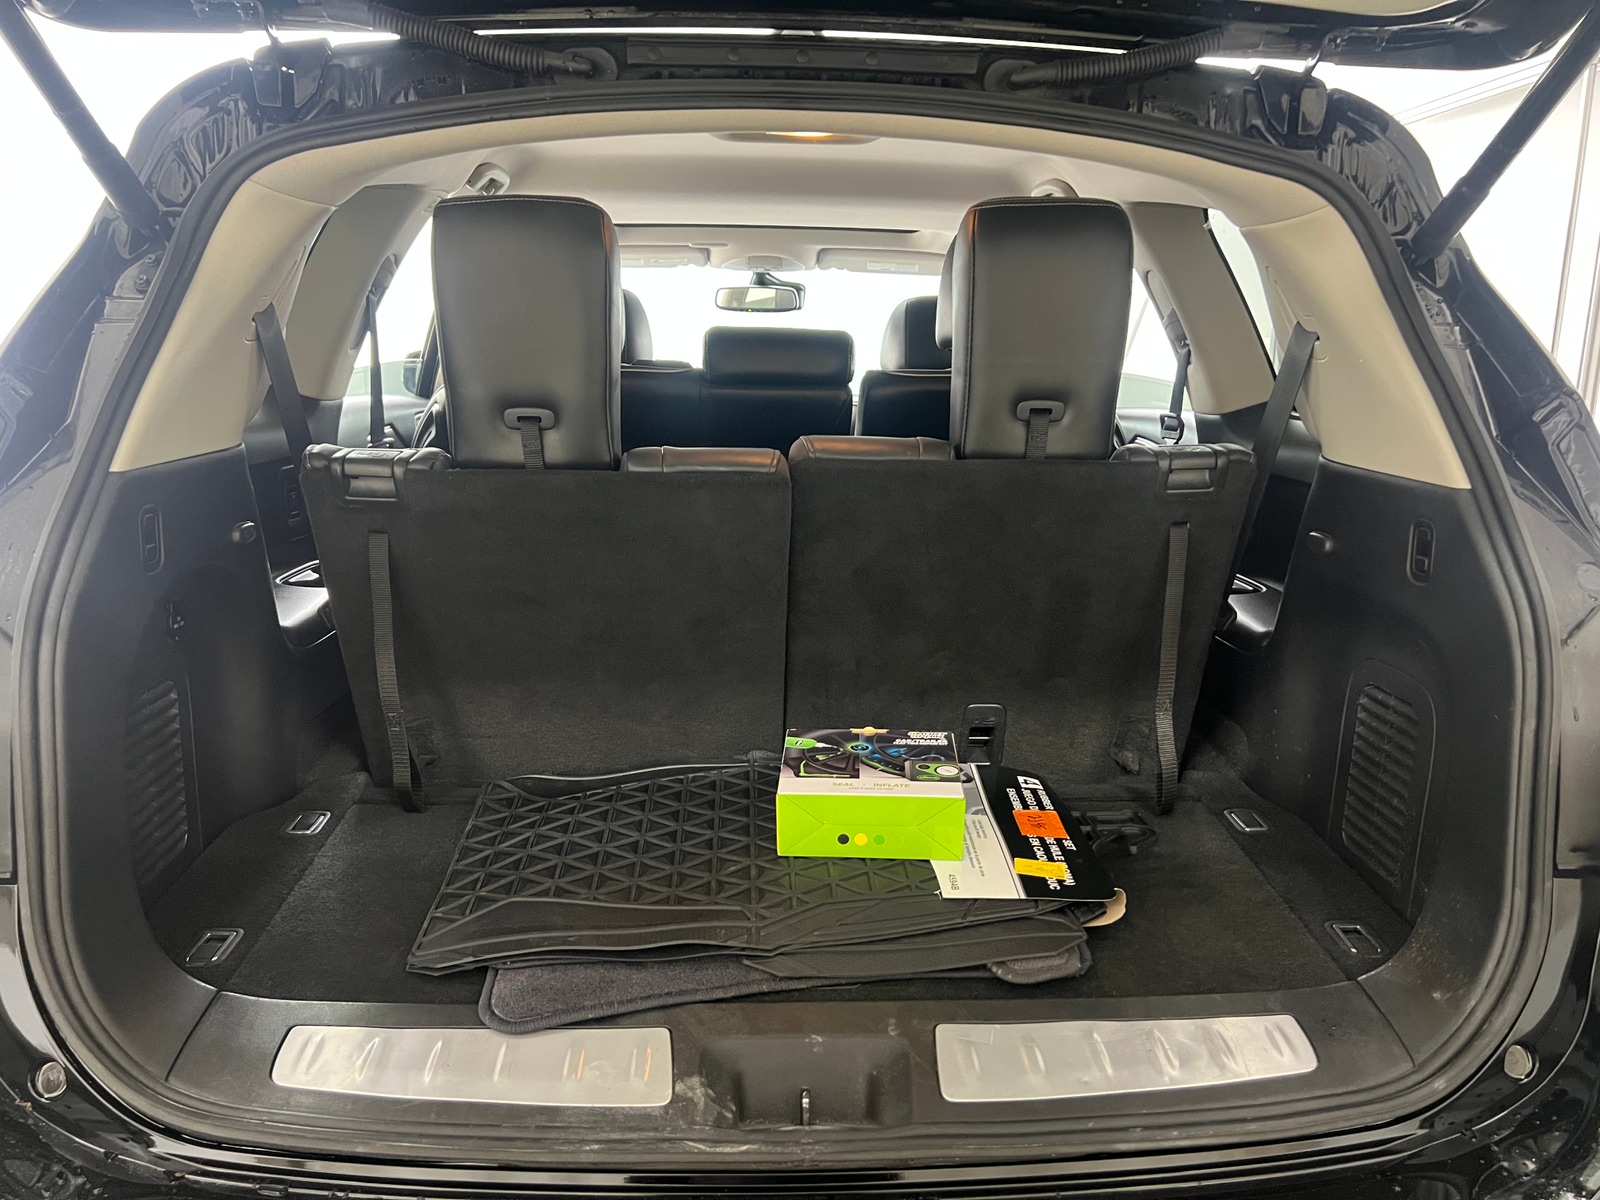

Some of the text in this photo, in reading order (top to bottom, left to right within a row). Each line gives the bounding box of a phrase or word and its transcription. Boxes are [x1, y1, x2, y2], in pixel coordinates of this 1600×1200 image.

[1021, 788, 1037, 806] JUEGO
[1036, 789, 1054, 810] RUBBER
[1062, 839, 1077, 851] SET
[1028, 837, 1041, 846] EN
